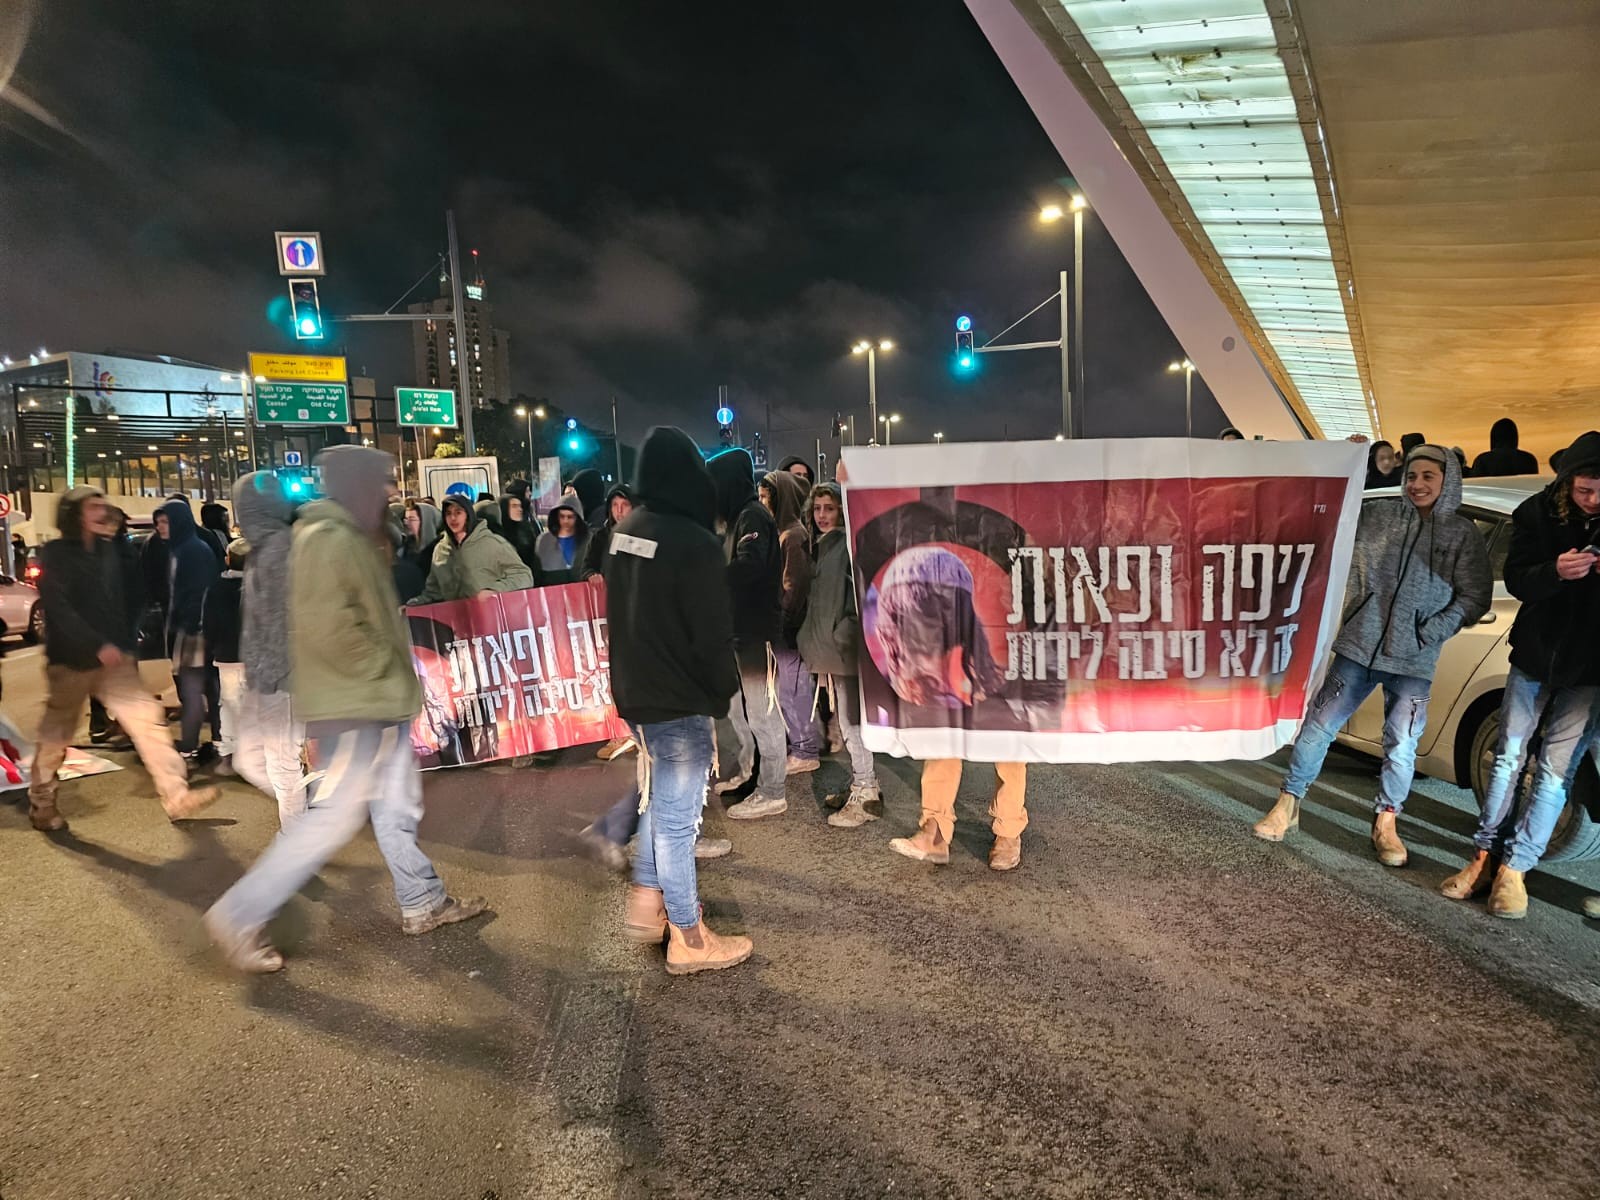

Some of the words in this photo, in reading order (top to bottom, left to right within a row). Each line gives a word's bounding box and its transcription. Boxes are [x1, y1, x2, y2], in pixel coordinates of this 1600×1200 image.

[1006, 544, 1173, 624] ופאות
[445, 625, 561, 694] ופאות
[1004, 625, 1104, 681] לירות
[1118, 629, 1206, 680] סיבה
[1219, 624, 1268, 678] לא
